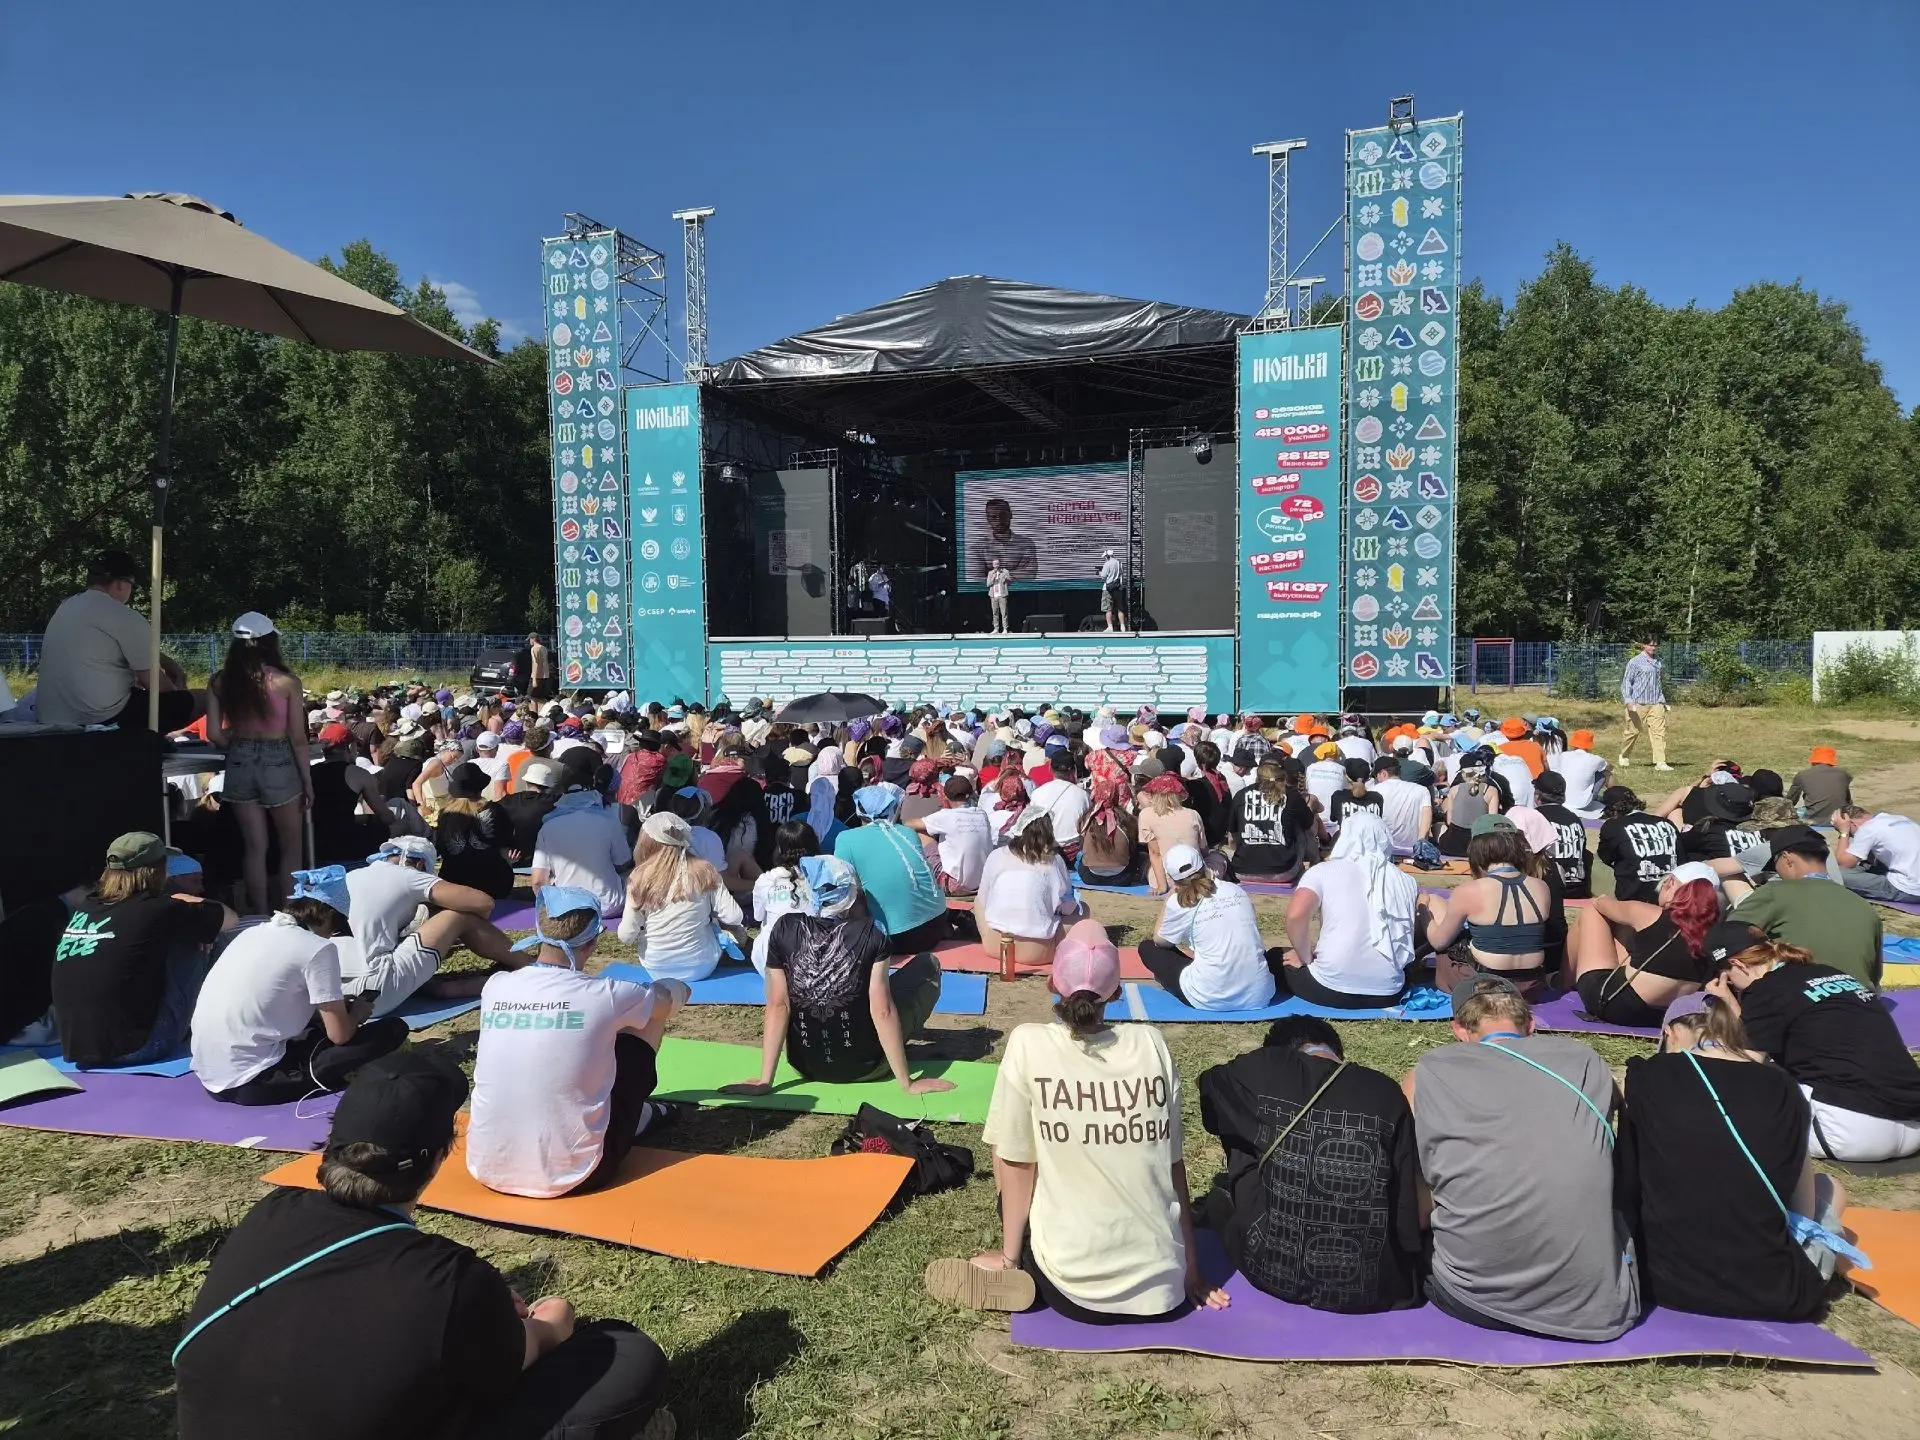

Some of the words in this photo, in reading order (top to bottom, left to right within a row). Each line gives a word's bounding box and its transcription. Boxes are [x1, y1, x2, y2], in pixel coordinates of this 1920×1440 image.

[1255, 427, 1282, 437] 413
[1284, 424, 1328, 435] 000+
[1303, 450, 1330, 460] 125
[1293, 499, 1313, 507] 72
[1271, 532, 1307, 543] СПО
[1250, 554, 1270, 565] 10
[1267, 581, 1290, 591] 141
[1291, 582, 1329, 593] 087
[492, 1001, 571, 1011] ДВИЖЕНИЕ
[481, 1010, 585, 1030] НОВЫЕ
[1034, 1075, 1167, 1118] ТАНЦУЮ
[1039, 1119, 1070, 1143] по
[1082, 1112, 1171, 1145] любви
